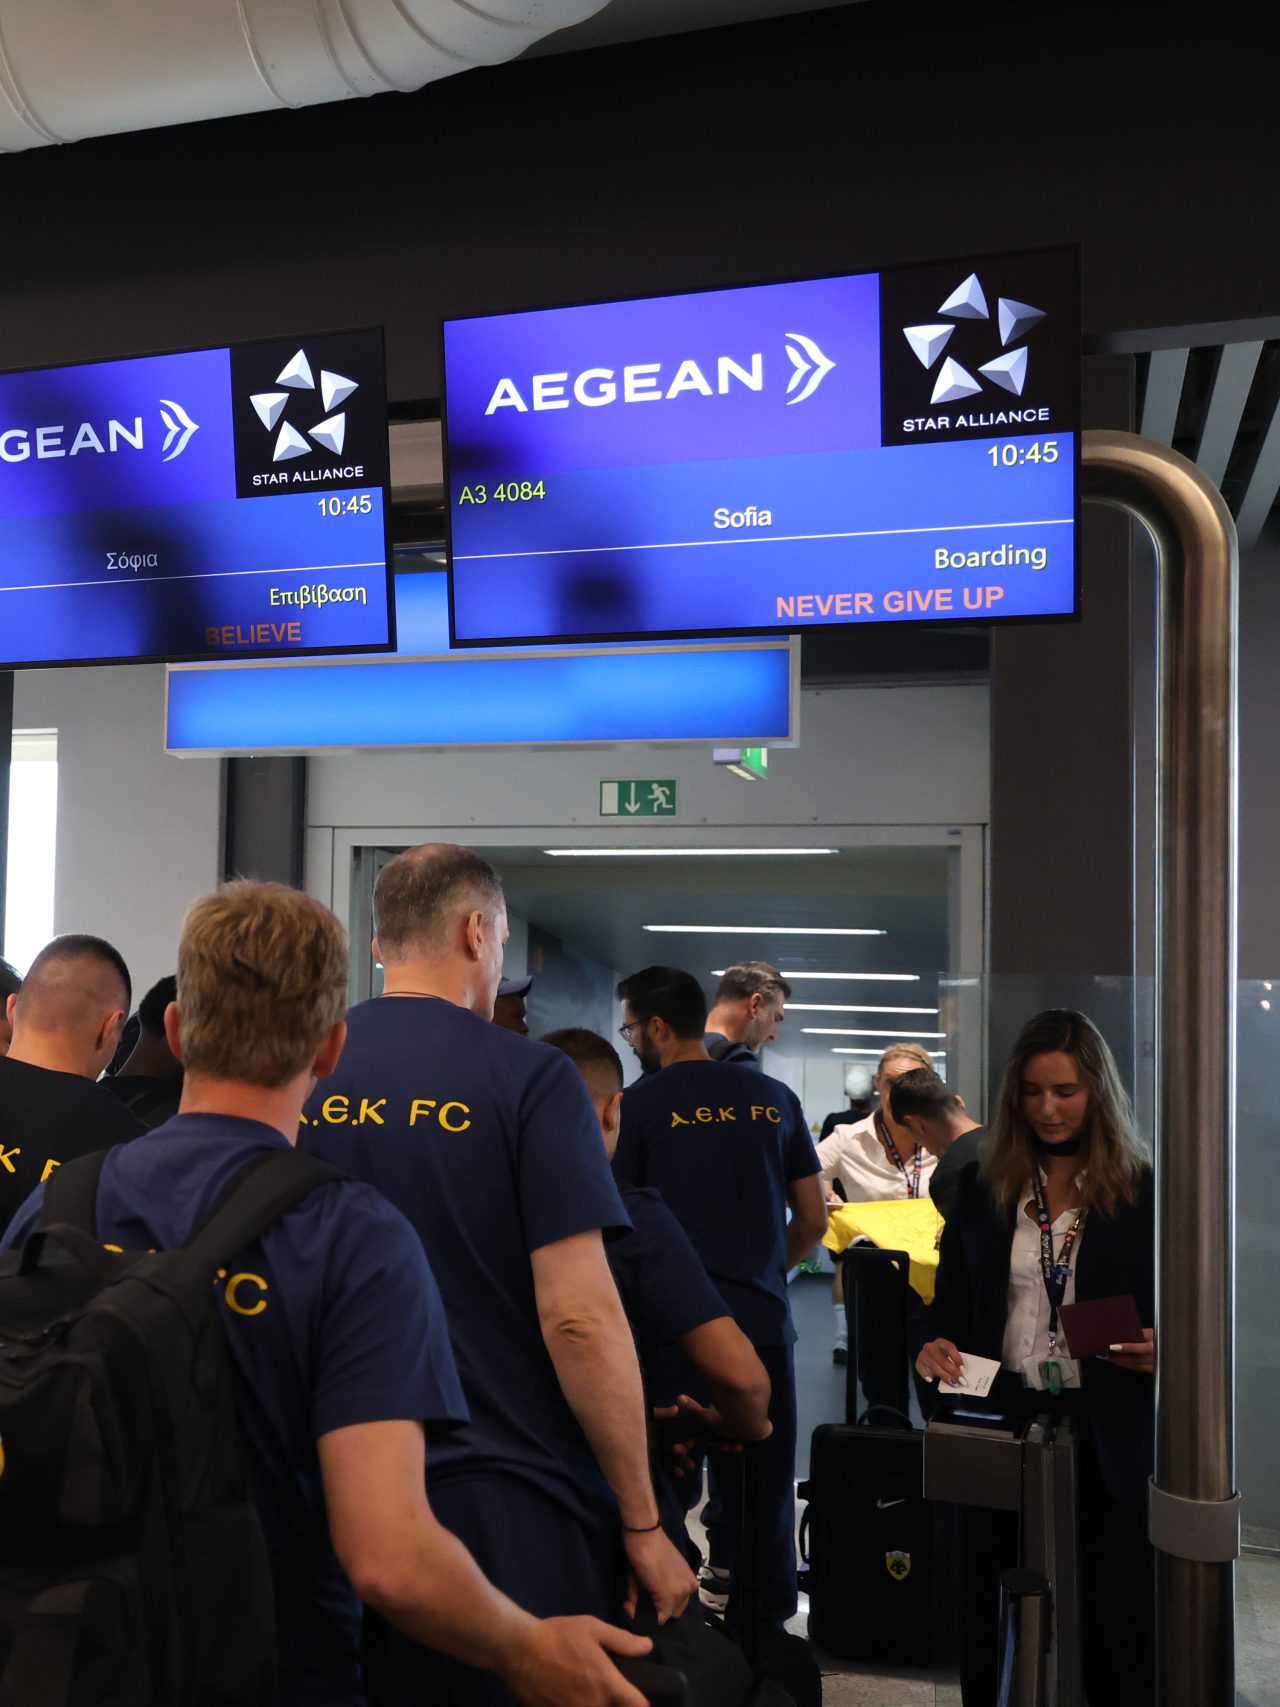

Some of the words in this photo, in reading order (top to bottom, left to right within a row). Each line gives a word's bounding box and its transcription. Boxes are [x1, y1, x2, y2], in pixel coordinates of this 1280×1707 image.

[485, 353, 763, 415] AEGEAN
[902, 415, 950, 432] STAR
[955, 408, 1050, 428] ALLIANCE
[987, 441, 1059, 467] 10:45
[252, 472, 288, 486] STAR
[293, 465, 364, 482] ALLIANCE
[459, 485, 488, 504] A3
[493, 481, 546, 502] 4084
[318, 495, 373, 517] 10:45
[714, 507, 773, 529] Sofia
[106, 551, 158, 573] Σόφια
[934, 544, 1048, 571] Boarding
[270, 584, 367, 610] Επιβίβαση
[776, 592, 875, 618] NEVER
[883, 589, 953, 614] GIVE
[963, 586, 1004, 609] UP
[207, 622, 302, 645] BELIEVE
[409, 1099, 471, 1132] FC
[751, 1105, 781, 1123] FC
[39, 1158, 62, 1183] F
